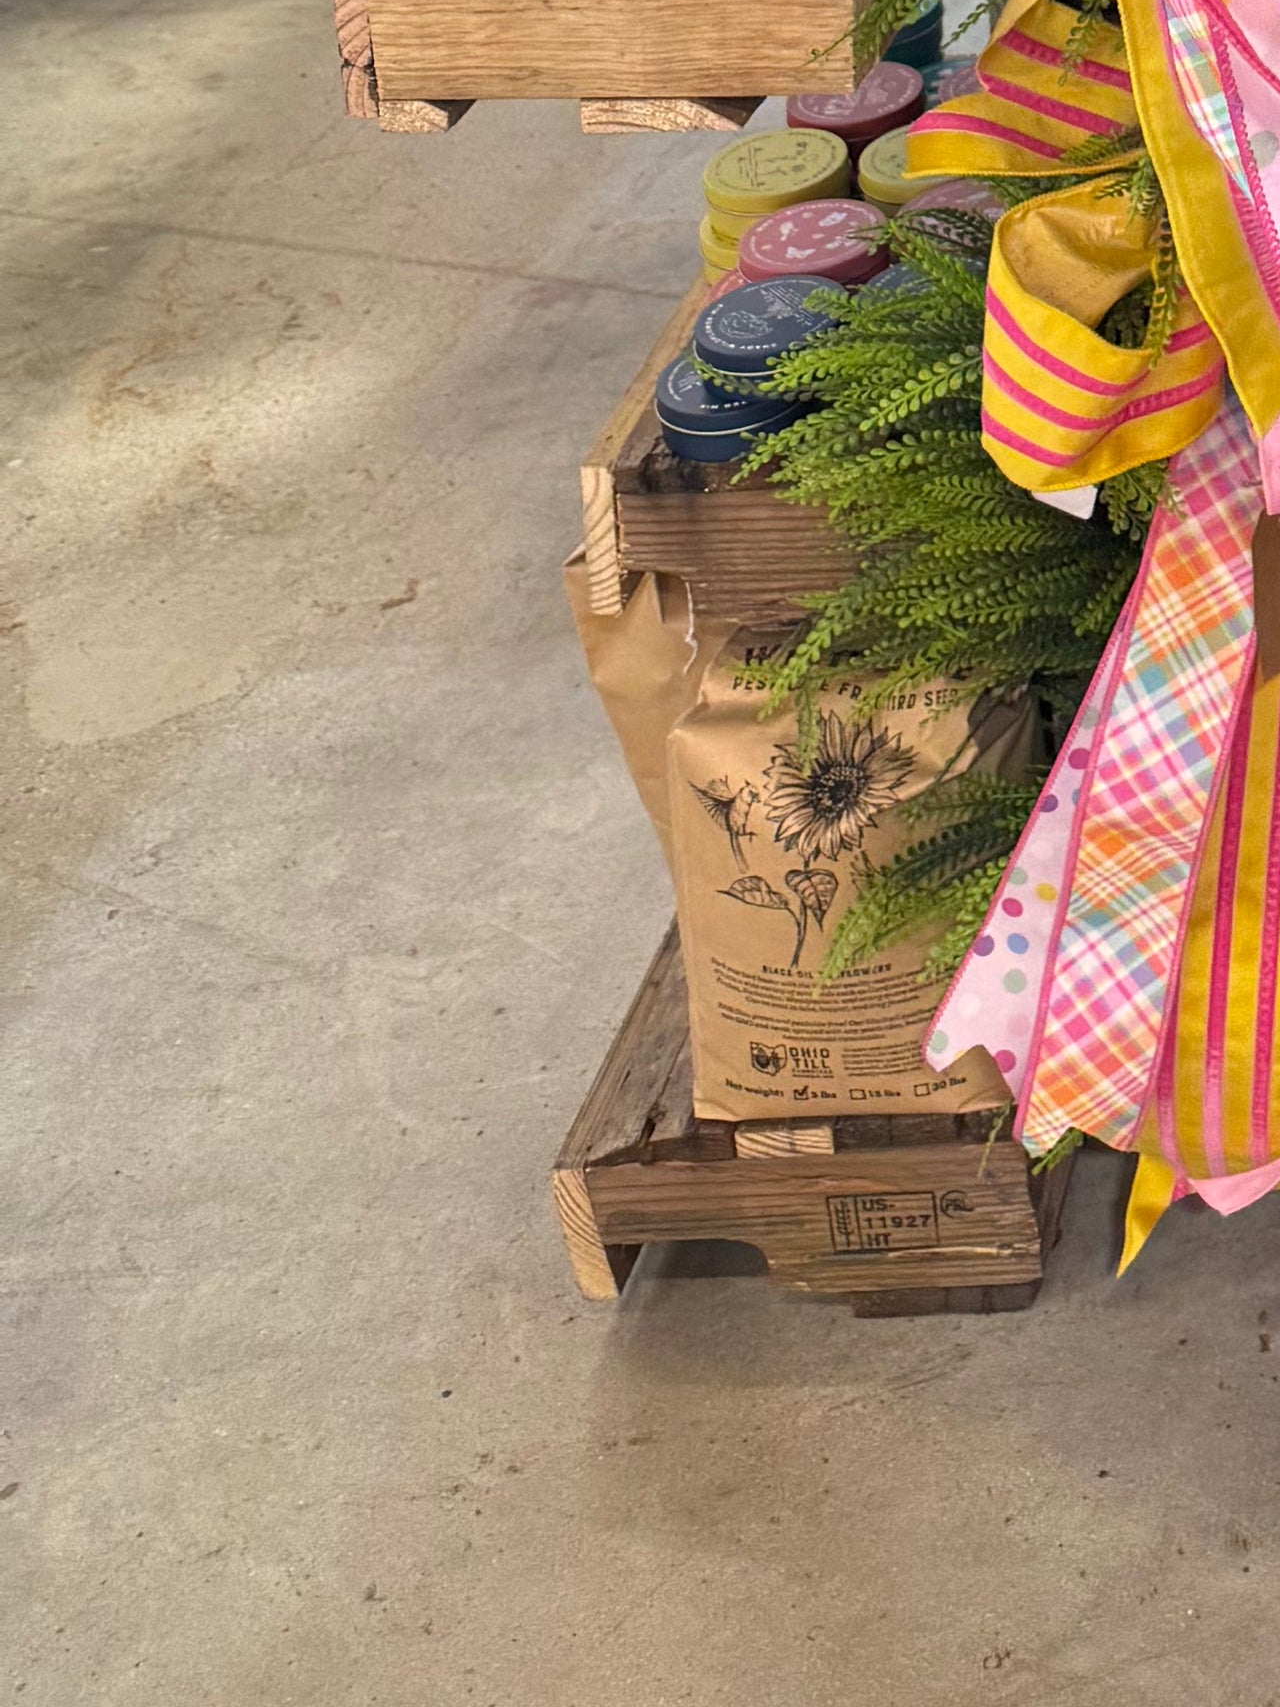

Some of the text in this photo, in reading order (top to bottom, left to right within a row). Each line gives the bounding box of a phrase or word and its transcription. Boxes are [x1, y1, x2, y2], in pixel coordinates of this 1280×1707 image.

[789, 1047, 831, 1059] OHIO
[793, 1057, 831, 1069] TILL
[862, 1198, 896, 1212] US-
[863, 1214, 931, 1229] 11927
